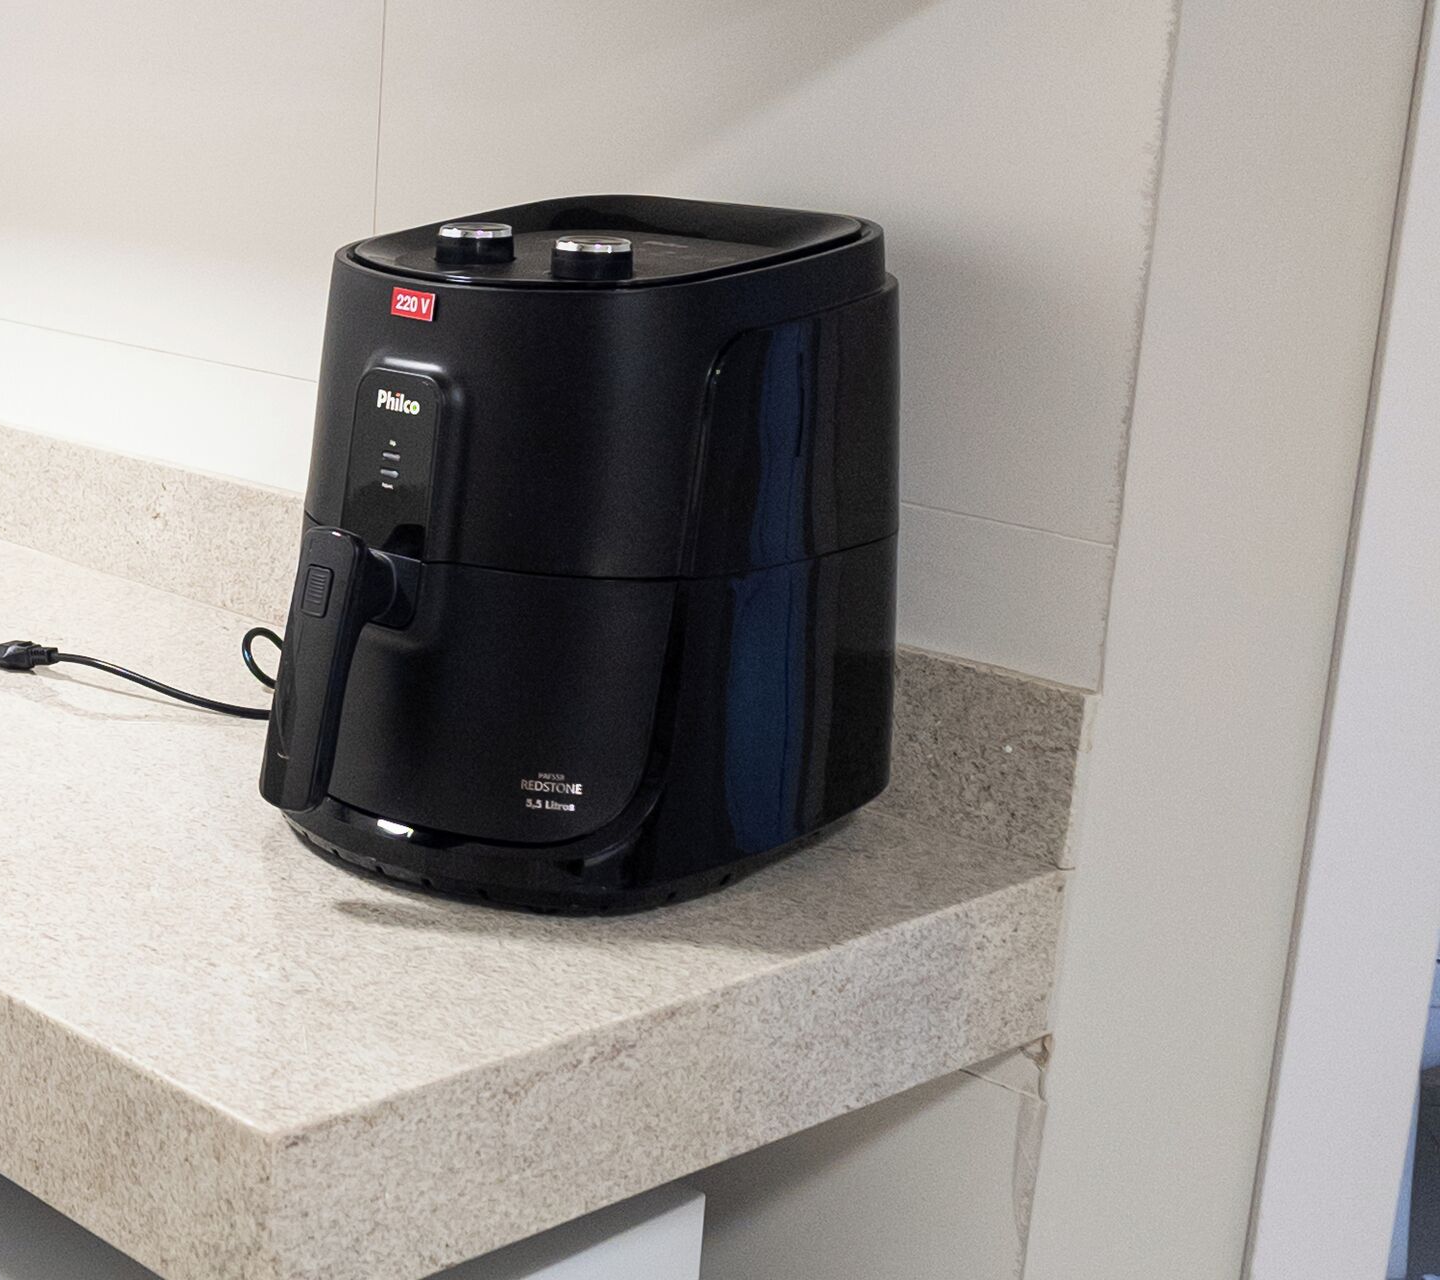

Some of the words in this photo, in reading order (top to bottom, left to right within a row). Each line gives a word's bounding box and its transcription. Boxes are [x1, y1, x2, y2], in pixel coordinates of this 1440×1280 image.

[395, 294, 418, 312] 220
[421, 298, 431, 314] V
[377, 389, 421, 415] Philco
[520, 779, 583, 796] REDSTONE
[545, 800, 576, 812] Litros
